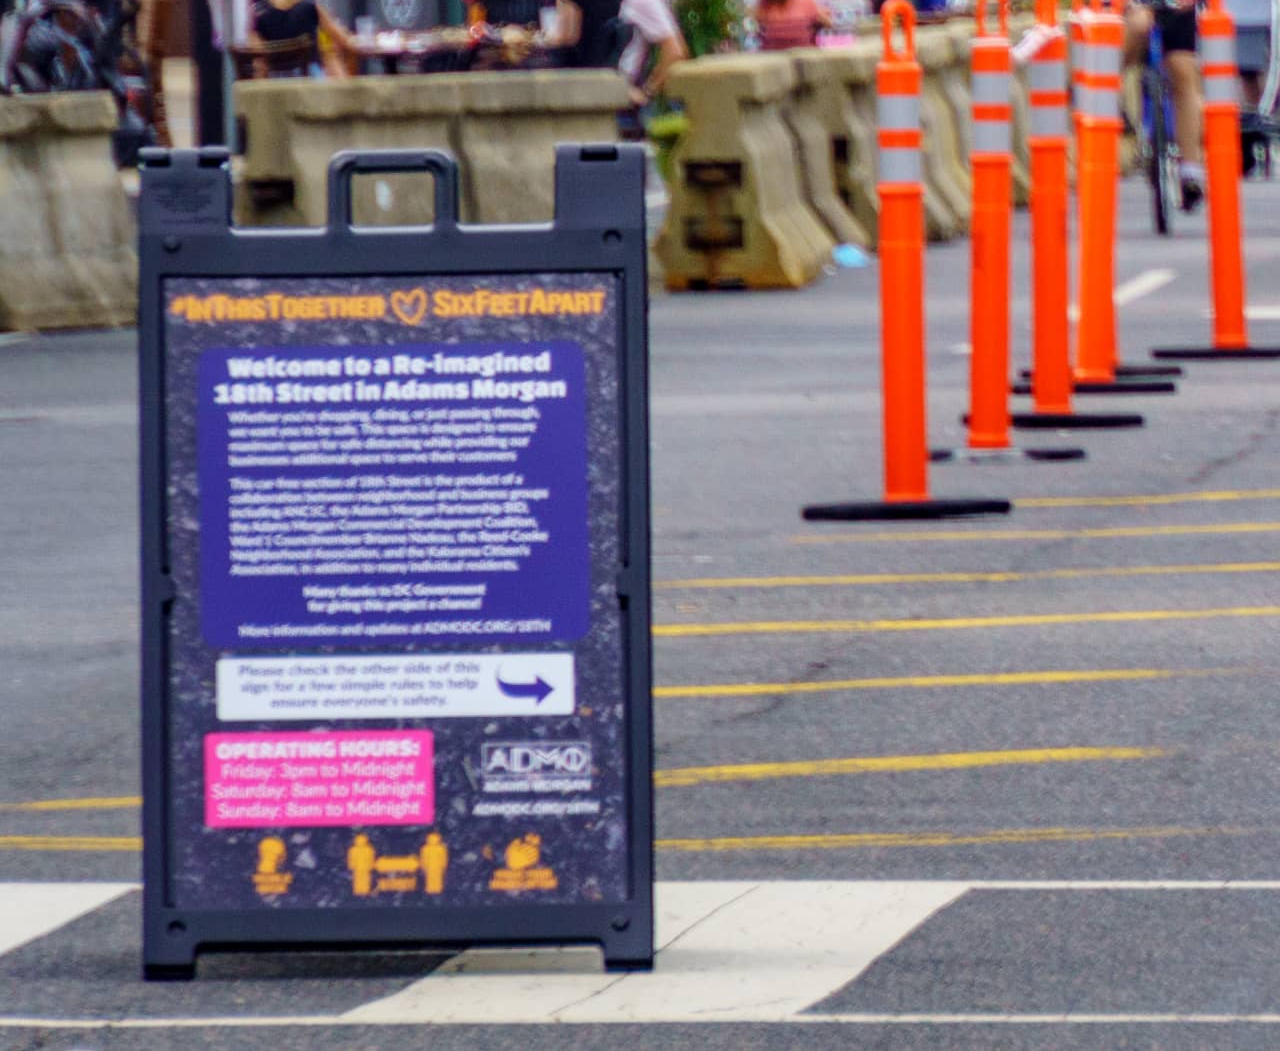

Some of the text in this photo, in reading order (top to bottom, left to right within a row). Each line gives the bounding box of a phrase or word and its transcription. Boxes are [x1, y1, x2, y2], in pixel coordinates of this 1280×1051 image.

[227, 355, 342, 378] Welcome
[344, 356, 372, 376] to
[373, 358, 391, 375] a
[213, 378, 567, 404] 18th Street in Adams Morgan
[227, 411, 279, 423] Whether
[279, 428, 300, 438] you
[315, 426, 331, 436] be
[360, 424, 384, 435] This
[431, 422, 482, 435] designed
[484, 422, 496, 433] to
[227, 441, 286, 452] maximum
[228, 478, 254, 490] This
[386, 475, 421, 487] Street
[454, 474, 500, 487] product
[351, 506, 389, 517] Adams
[391, 504, 436, 517] Morgan
[302, 586, 337, 599] Many
[337, 586, 377, 598] thanks
[378, 586, 392, 597] to
[392, 584, 413, 596] DC
[306, 601, 326, 612] for
[327, 600, 361, 615] giving
[362, 600, 385, 612] this
[386, 600, 427, 613] project
[428, 602, 437, 610] a
[238, 624, 270, 637] More
[271, 624, 339, 636] information
[341, 623, 364, 635] and
[365, 623, 408, 636] updates
[239, 661, 481, 675] Please check the other side of this
[240, 678, 478, 694] sign for a few simple rules to help
[270, 698, 317, 708] ensure
[215, 739, 421, 759] OPERATING HOURS:
[487, 748, 587, 772] ADMO
[221, 761, 415, 780] Friday: 3pm to Midnight
[211, 780, 426, 800] Saturday: 8am to Midnight
[217, 800, 420, 820] Sunday: 8am to Midnight
